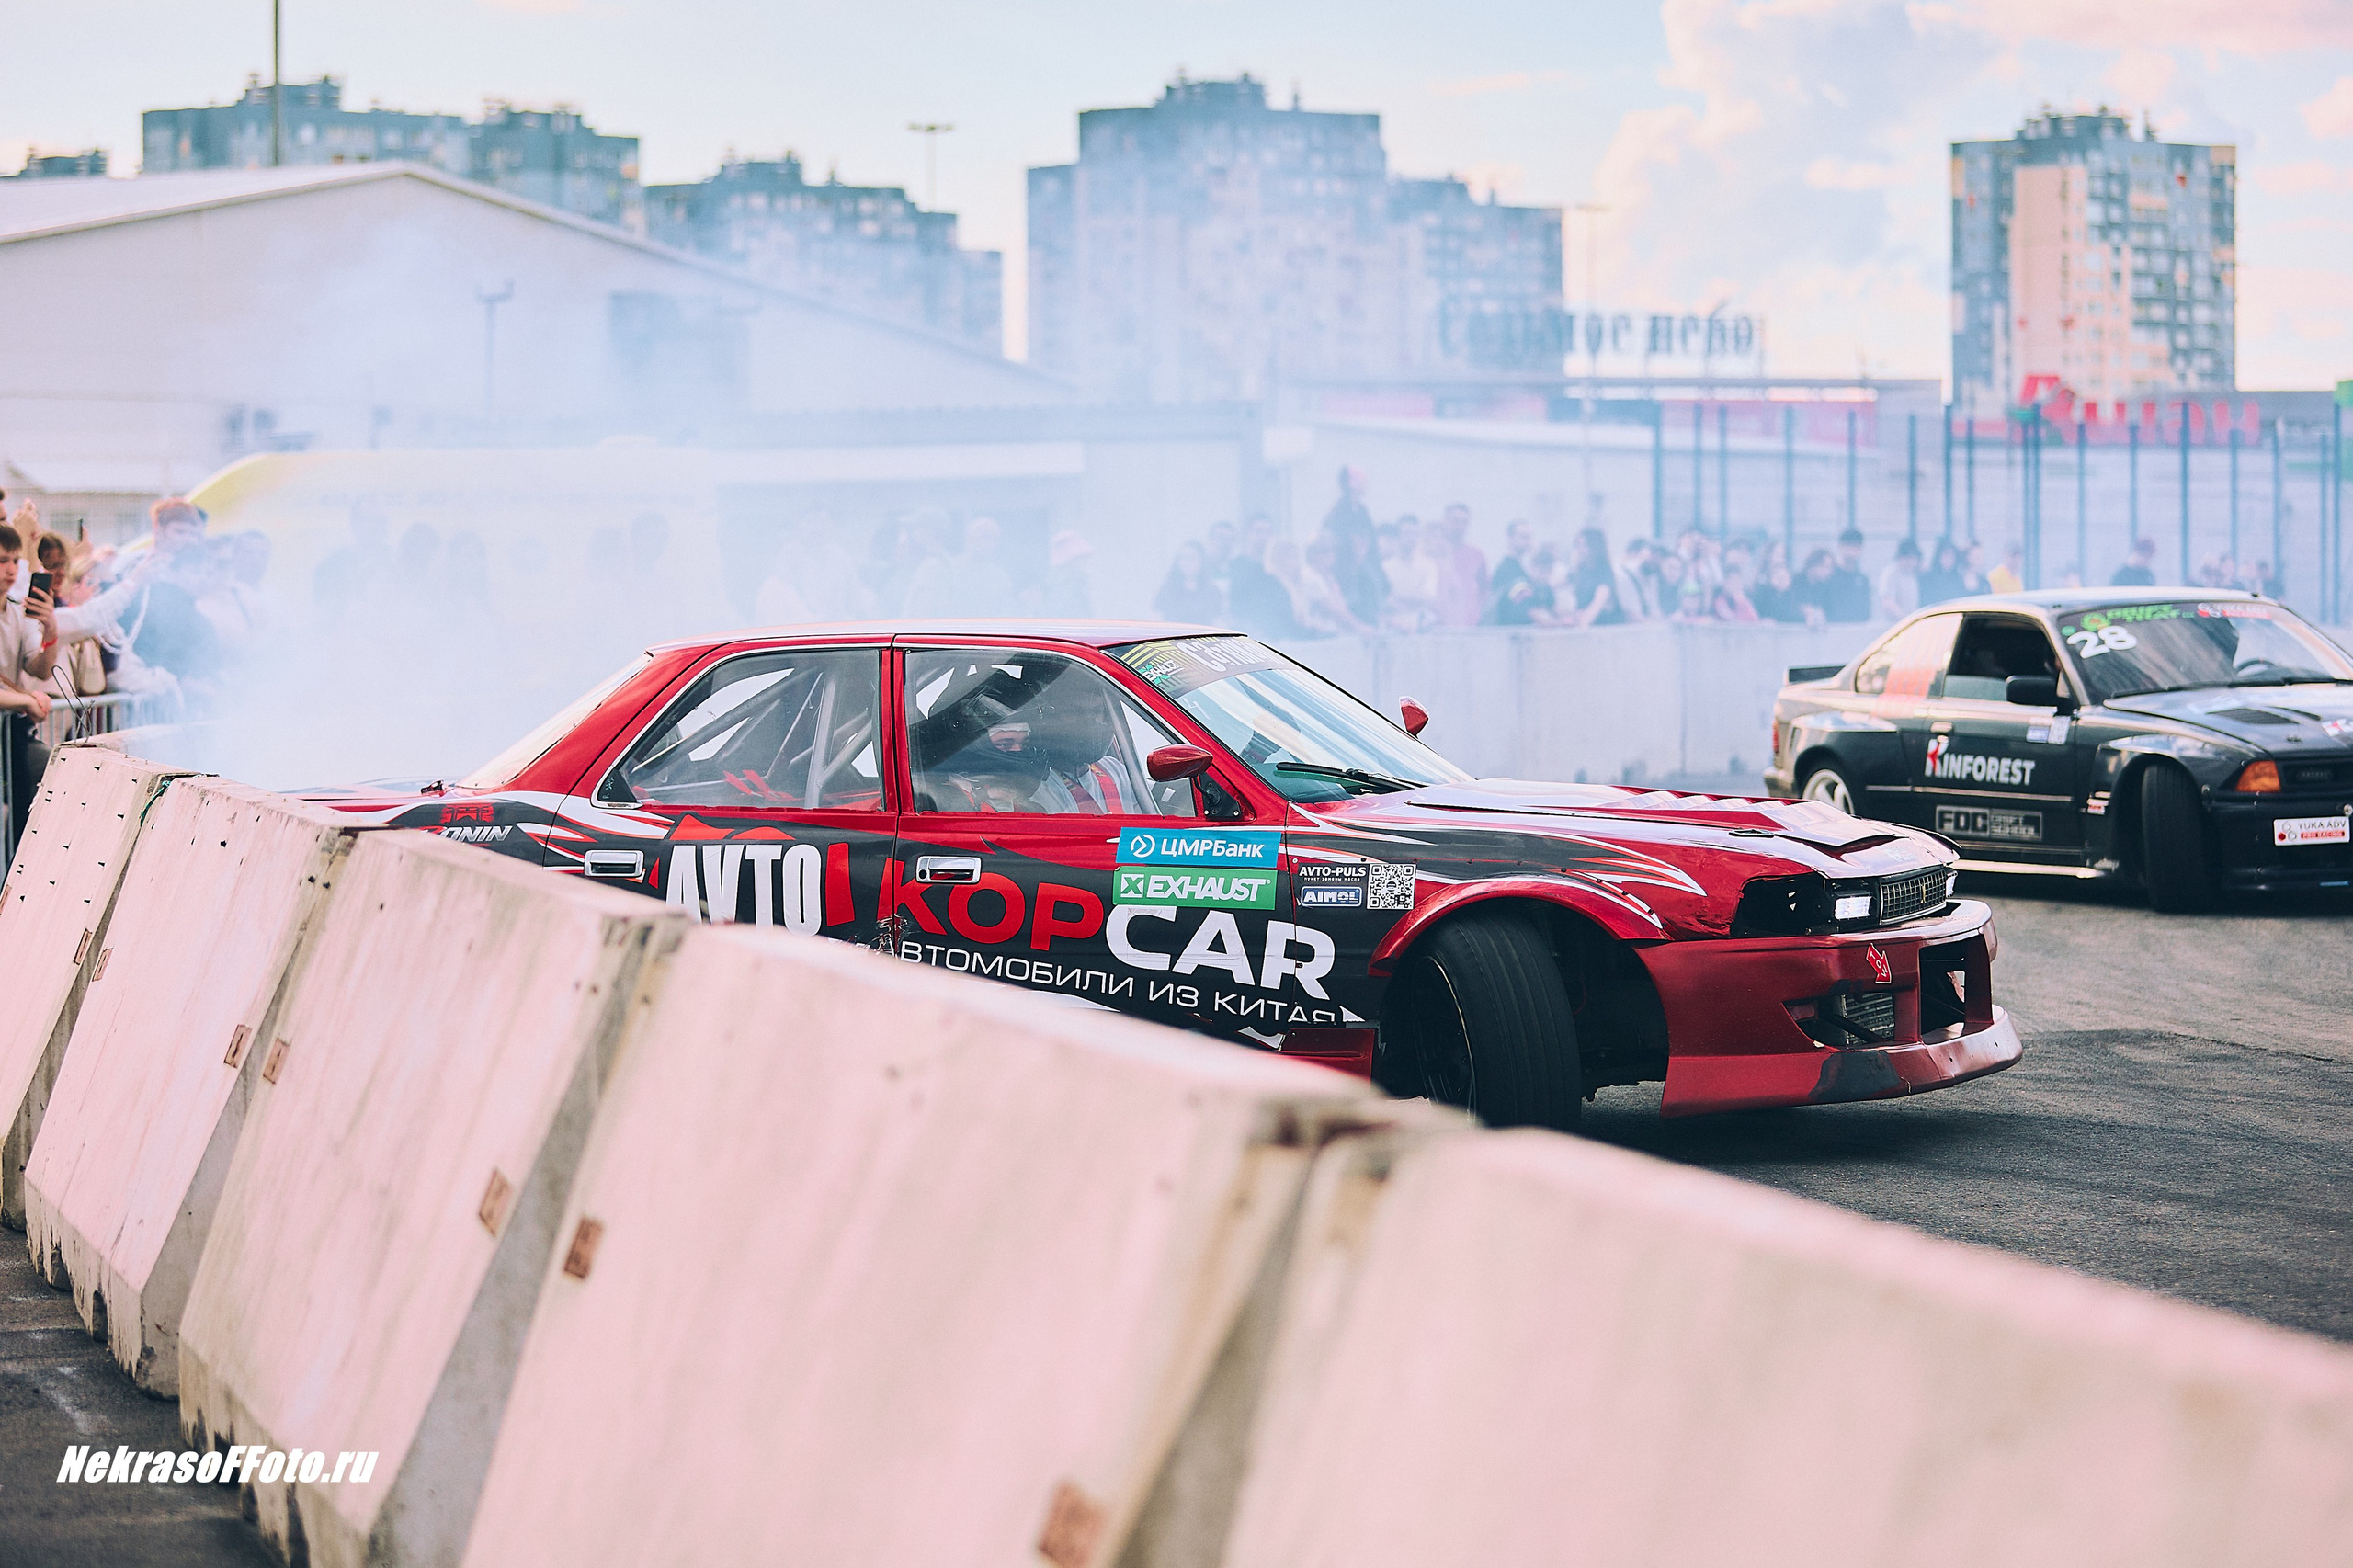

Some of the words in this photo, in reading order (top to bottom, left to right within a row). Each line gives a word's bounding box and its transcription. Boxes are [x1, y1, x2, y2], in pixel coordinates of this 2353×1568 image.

[2066, 625, 2137, 659] 28
[1925, 738, 2036, 786] KINFOREST
[2298, 821, 2324, 831] YUKA
[2326, 820, 2347, 829] ADV
[1160, 837, 1265, 859] ЦМРБанк
[1299, 866, 1367, 878] AVTO-PULS
[665, 843, 822, 937] AVTO
[1147, 875, 1267, 902] EXHAUST
[1303, 891, 1359, 903] AIMOL
[1870, 951, 1887, 977] TOW
[1148, 980, 1199, 1008] ИЗ
